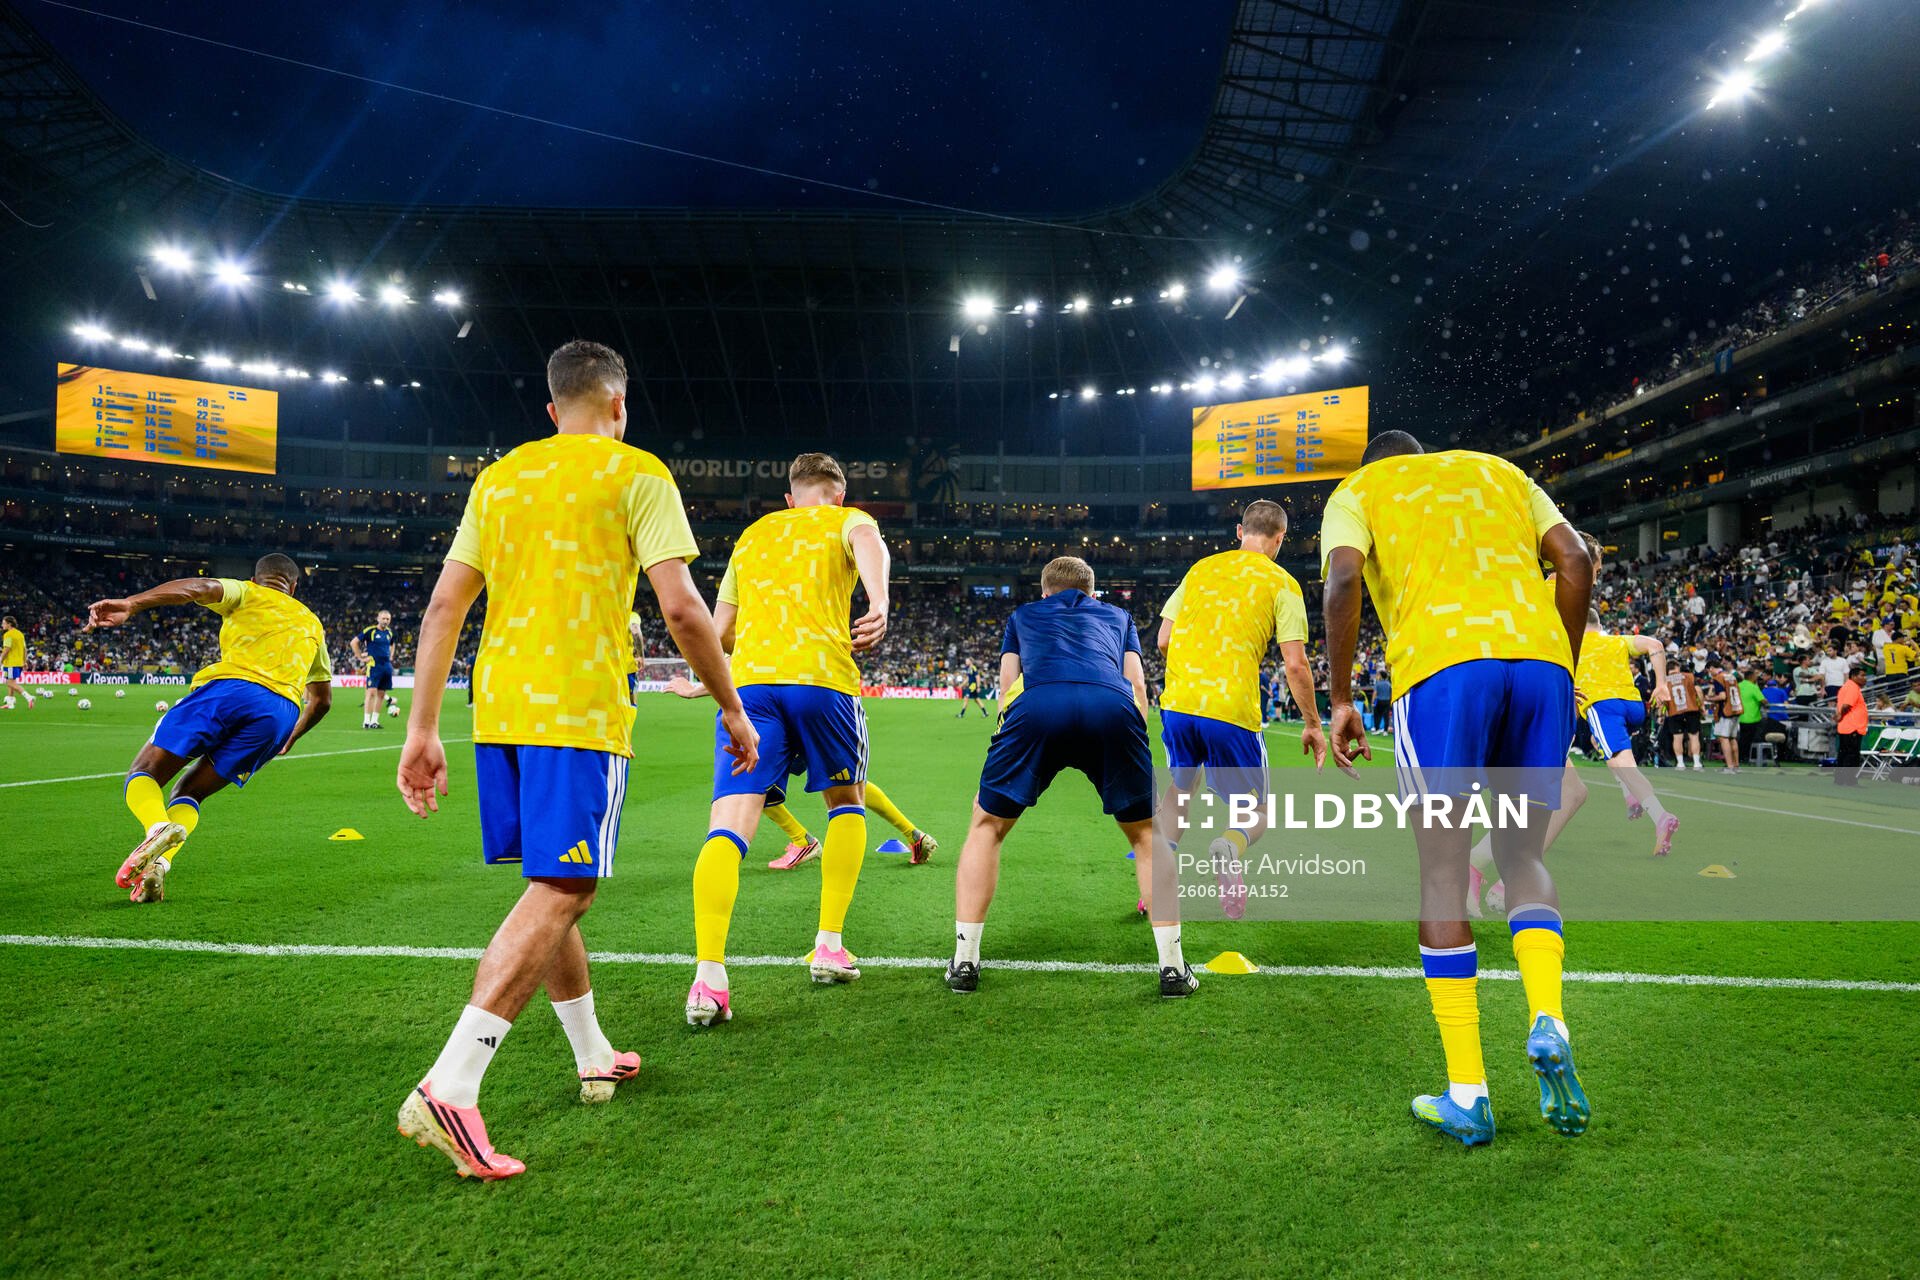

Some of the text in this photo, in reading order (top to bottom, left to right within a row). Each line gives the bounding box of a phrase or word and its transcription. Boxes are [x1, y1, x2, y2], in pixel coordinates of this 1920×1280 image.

[98, 385, 103, 394] 1
[147, 391, 156, 401] 11
[92, 397, 103, 407] 12
[146, 404, 156, 414] 13
[96, 411, 102, 420] 6
[197, 410, 208, 420] 22
[1258, 415, 1265, 425] 11
[145, 416, 156, 426] 14
[97, 424, 102, 433] 7
[196, 422, 207, 432] 24
[145, 429, 156, 439] 15
[196, 435, 207, 445] 25
[144, 442, 156, 452] 19
[671, 459, 888, 479] WORLD CU 26
[1750, 464, 1812, 488] MONTERREY
[93, 674, 129, 685] Rexona
[146, 674, 185, 685] Rexona
